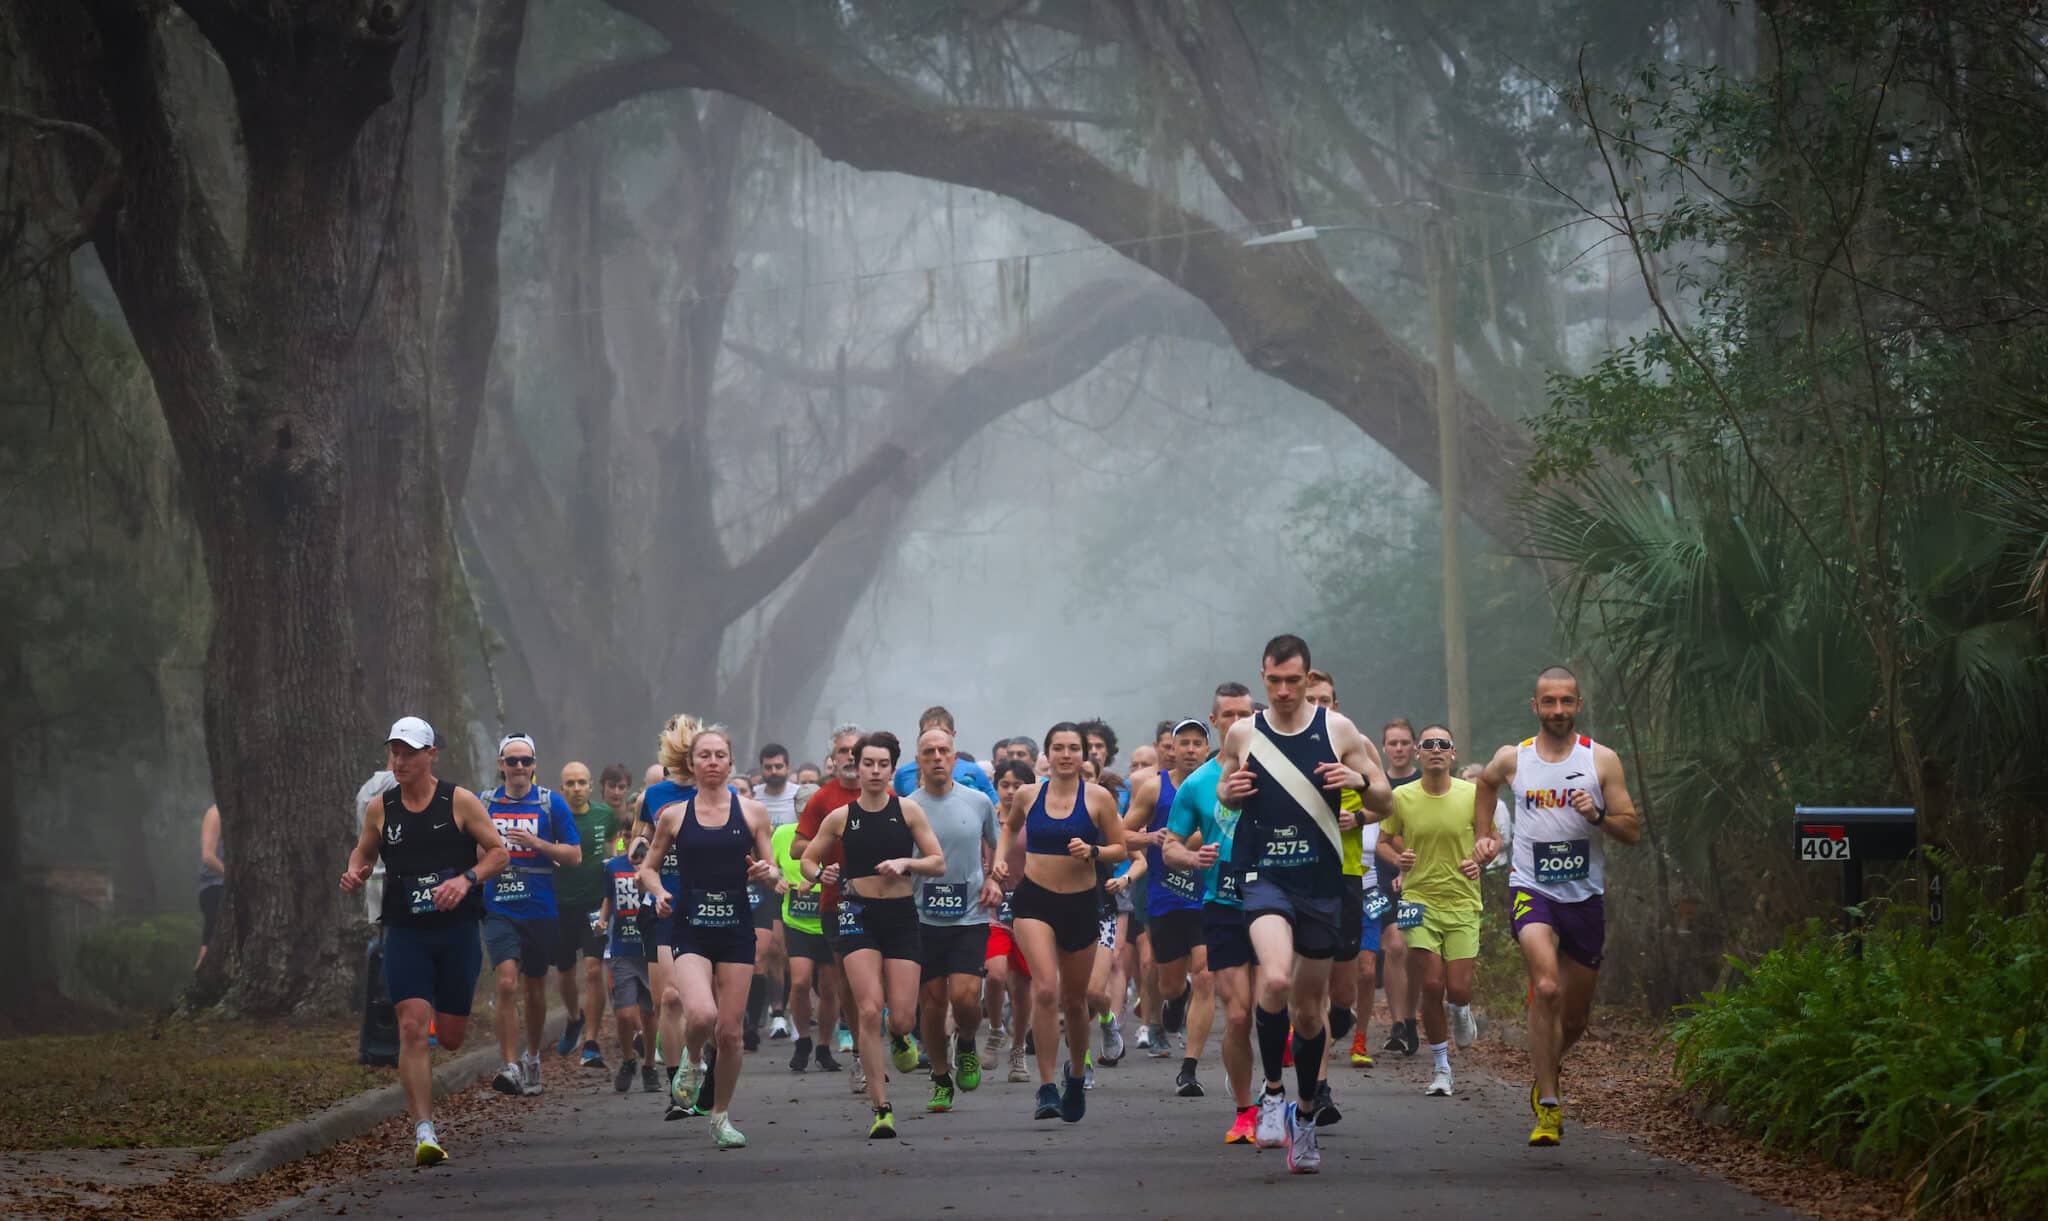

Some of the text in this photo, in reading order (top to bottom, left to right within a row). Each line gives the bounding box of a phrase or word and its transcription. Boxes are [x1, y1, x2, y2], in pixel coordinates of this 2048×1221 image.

[1526, 788, 1585, 810] PROJ
[1266, 840, 1311, 855] 2575
[1803, 839, 1848, 859] 402
[663, 854, 679, 866] 25
[1539, 856, 1584, 871] 2069
[496, 881, 525, 894] 2565
[1167, 873, 1195, 892] 2514
[411, 888, 434, 904] 24
[616, 893, 641, 910] PK
[747, 894, 760, 904] 23
[928, 896, 962, 908] 2452
[697, 903, 735, 917] 2553
[791, 900, 819, 911] 2017
[838, 912, 856, 925] 62
[1397, 907, 1418, 920] 449
[621, 925, 641, 936] 25
